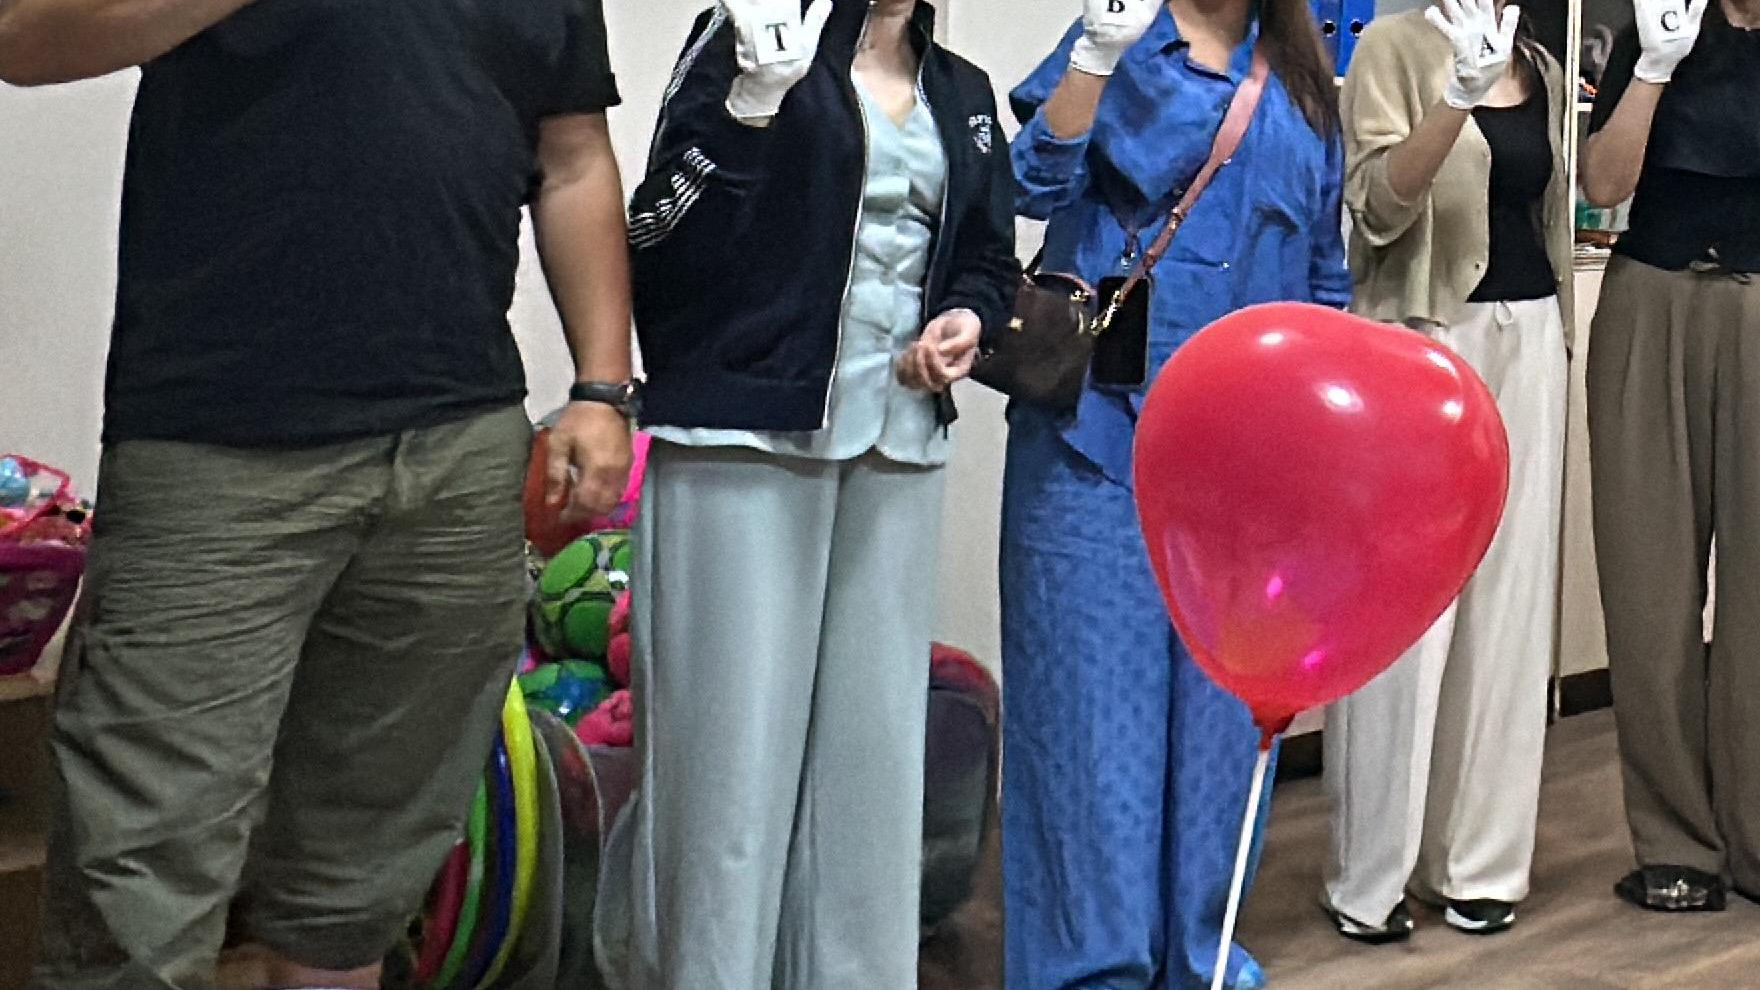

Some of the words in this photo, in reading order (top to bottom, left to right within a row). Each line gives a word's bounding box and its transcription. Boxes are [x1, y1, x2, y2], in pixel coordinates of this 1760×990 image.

[1660, 10, 1680, 32] С
[764, 22, 787, 51] Т
[1479, 34, 1497, 57] А
